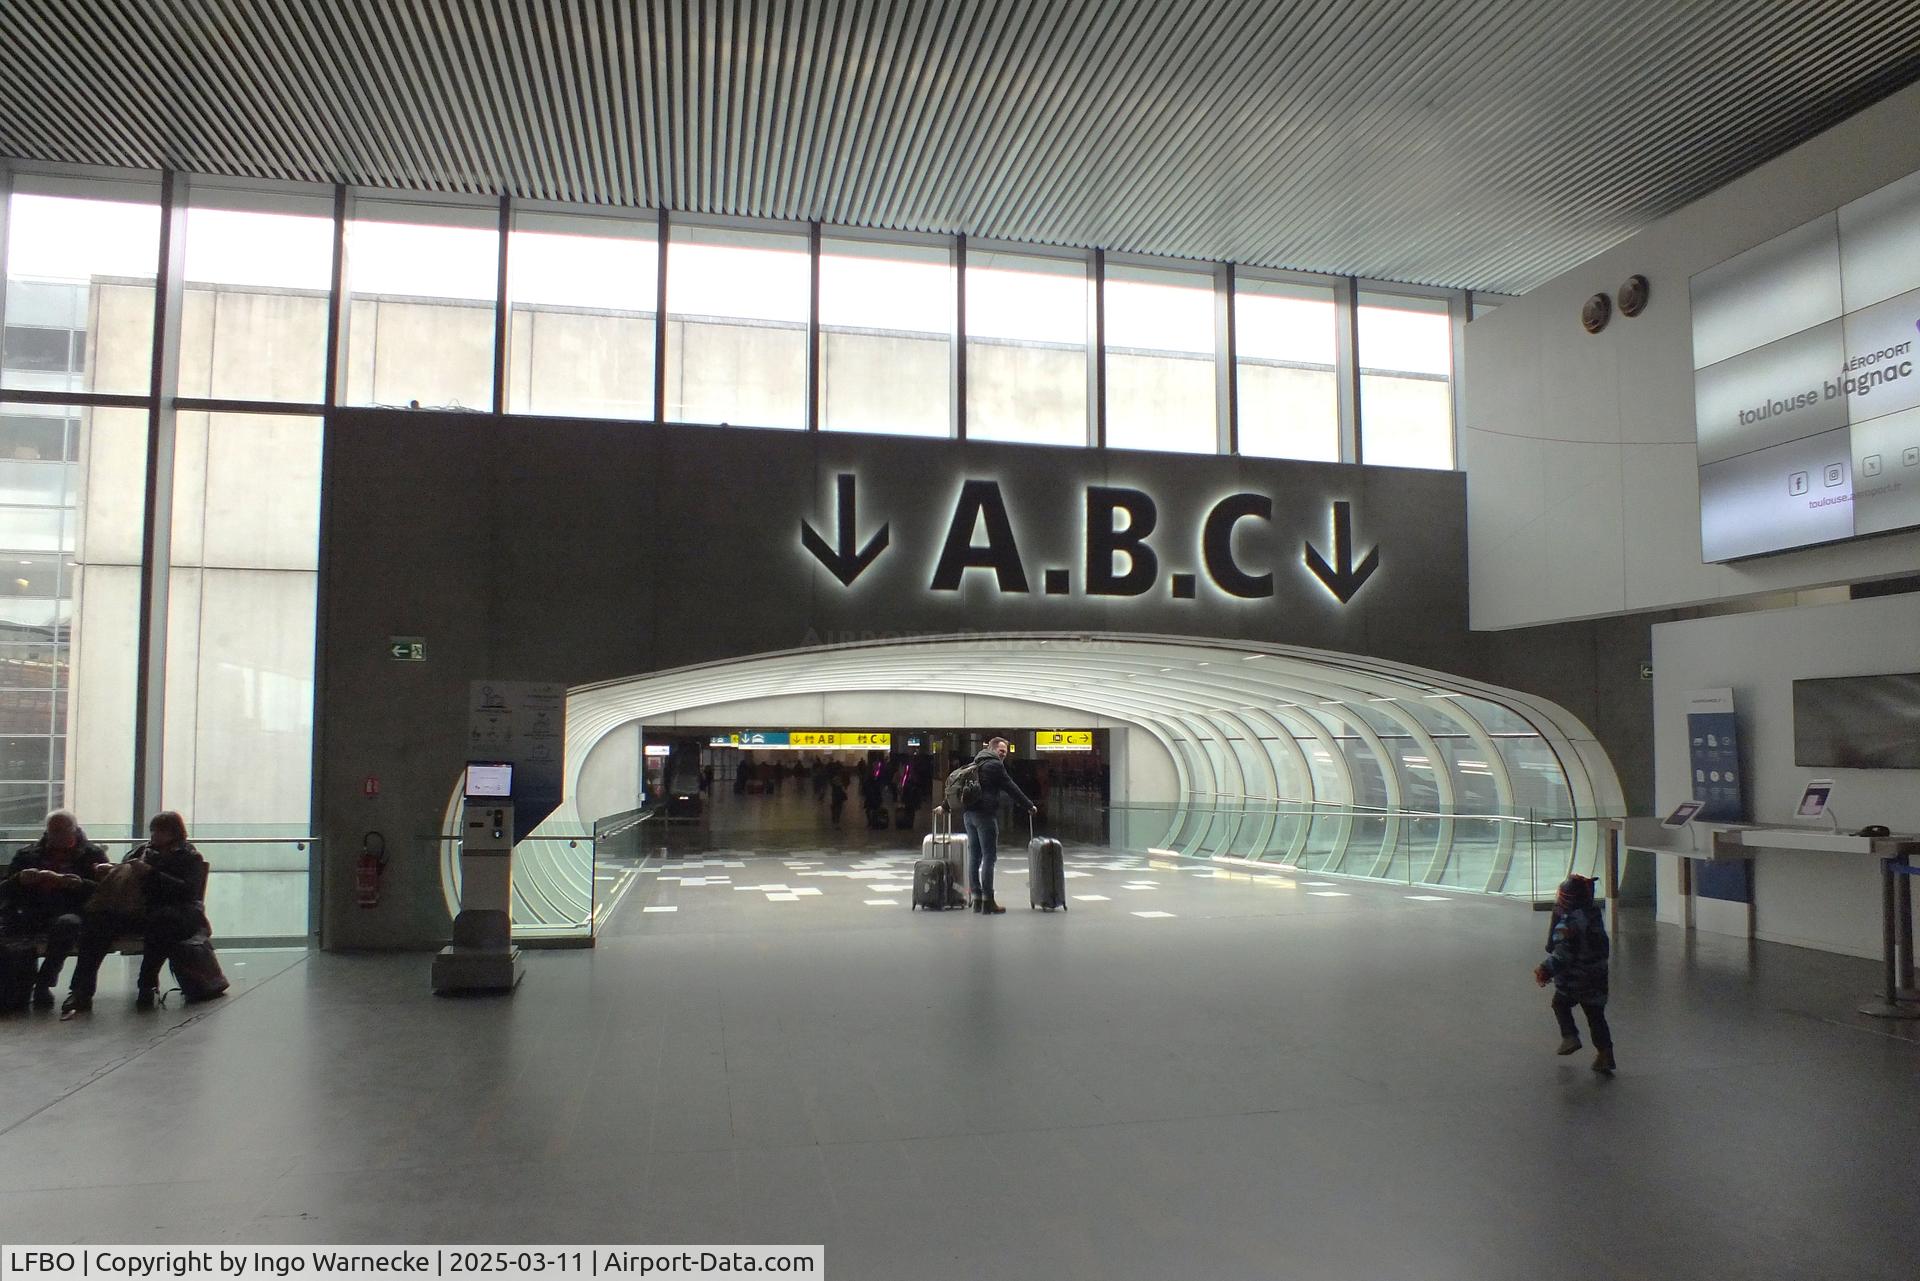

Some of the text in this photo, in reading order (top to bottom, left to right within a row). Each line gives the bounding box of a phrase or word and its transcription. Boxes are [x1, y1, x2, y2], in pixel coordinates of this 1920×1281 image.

[1841, 341, 1912, 374] AÉROPORT
[1738, 360, 1913, 426] toulouse blagnac
[817, 734, 835, 744] A B
[870, 734, 878, 744] C
[1066, 735, 1073, 744] C
